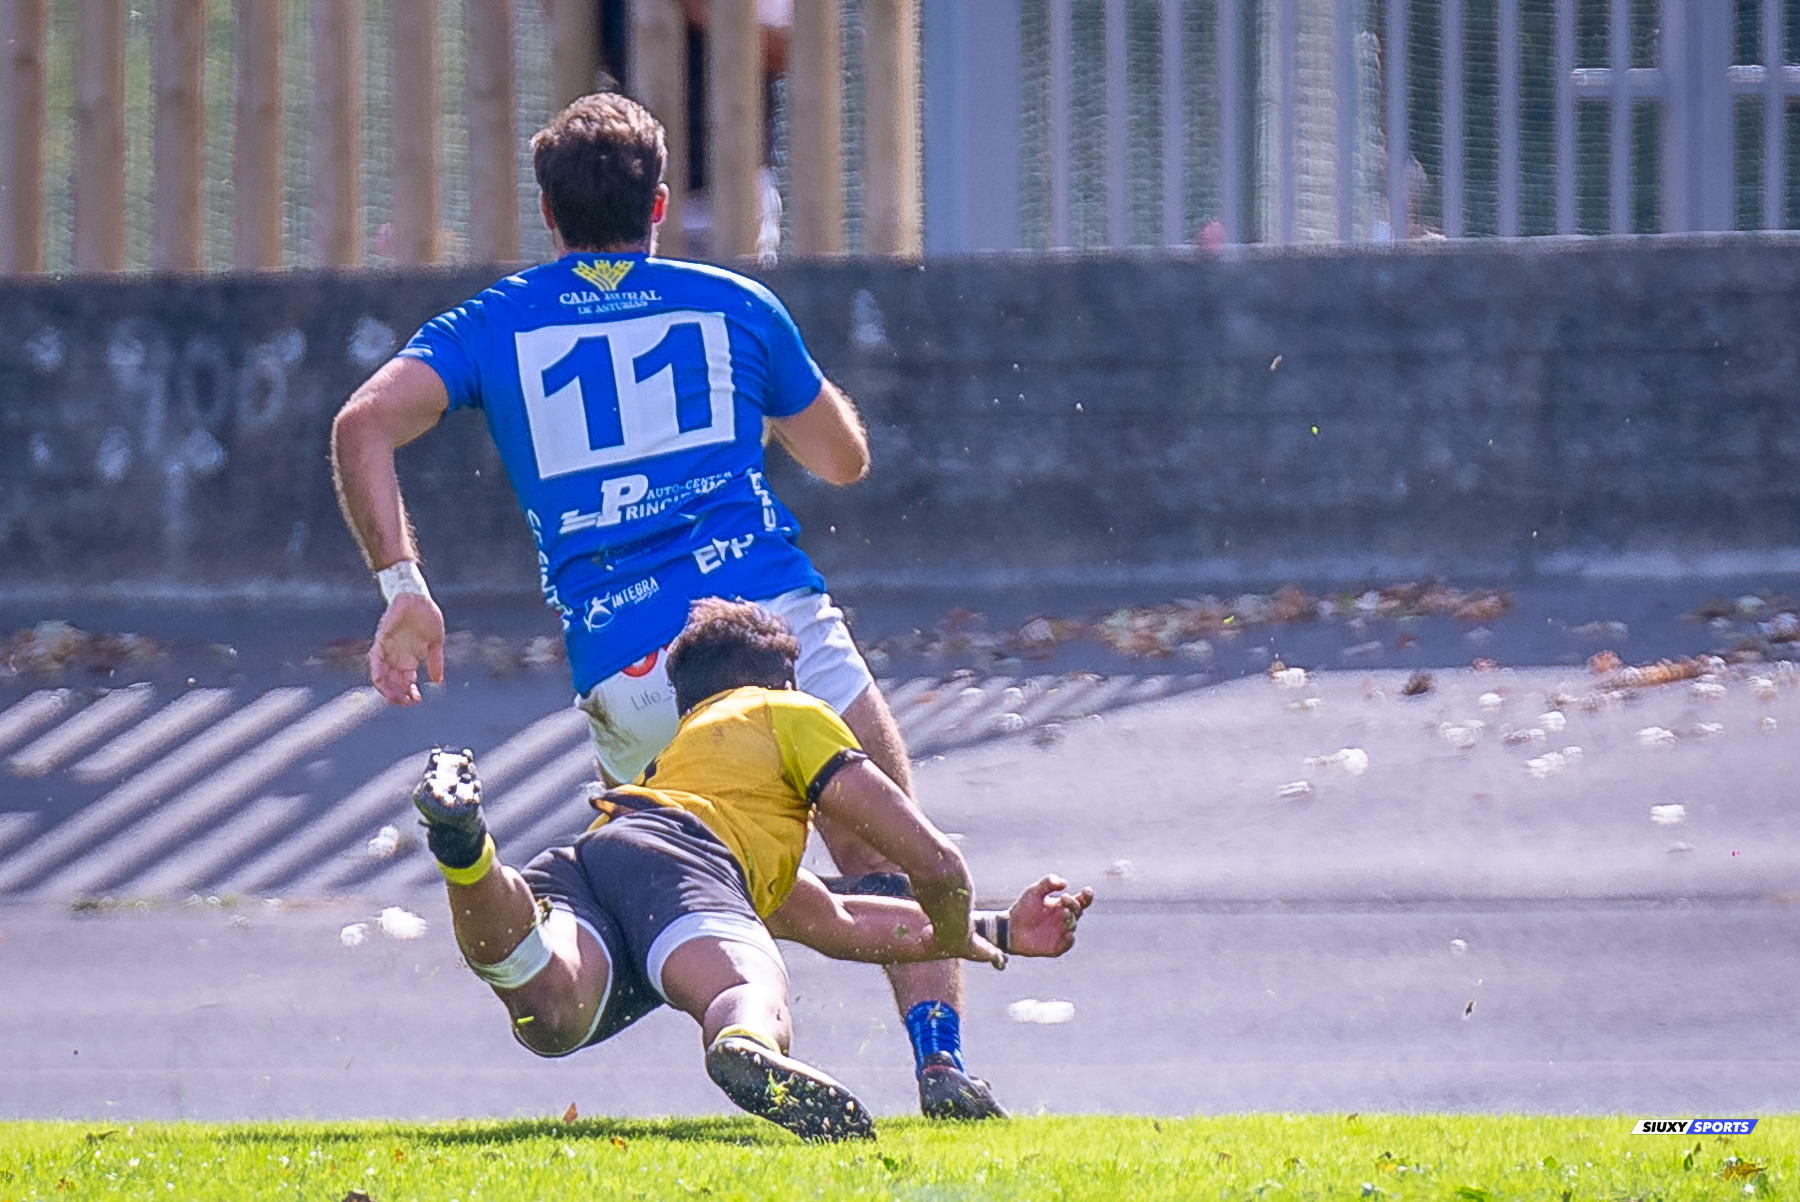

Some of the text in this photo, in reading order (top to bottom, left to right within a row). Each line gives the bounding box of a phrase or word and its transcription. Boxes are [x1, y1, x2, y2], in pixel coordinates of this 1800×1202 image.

[559, 291, 600, 305] CAJA
[541, 321, 713, 451] 11
[611, 576, 660, 608] INTEGRA
